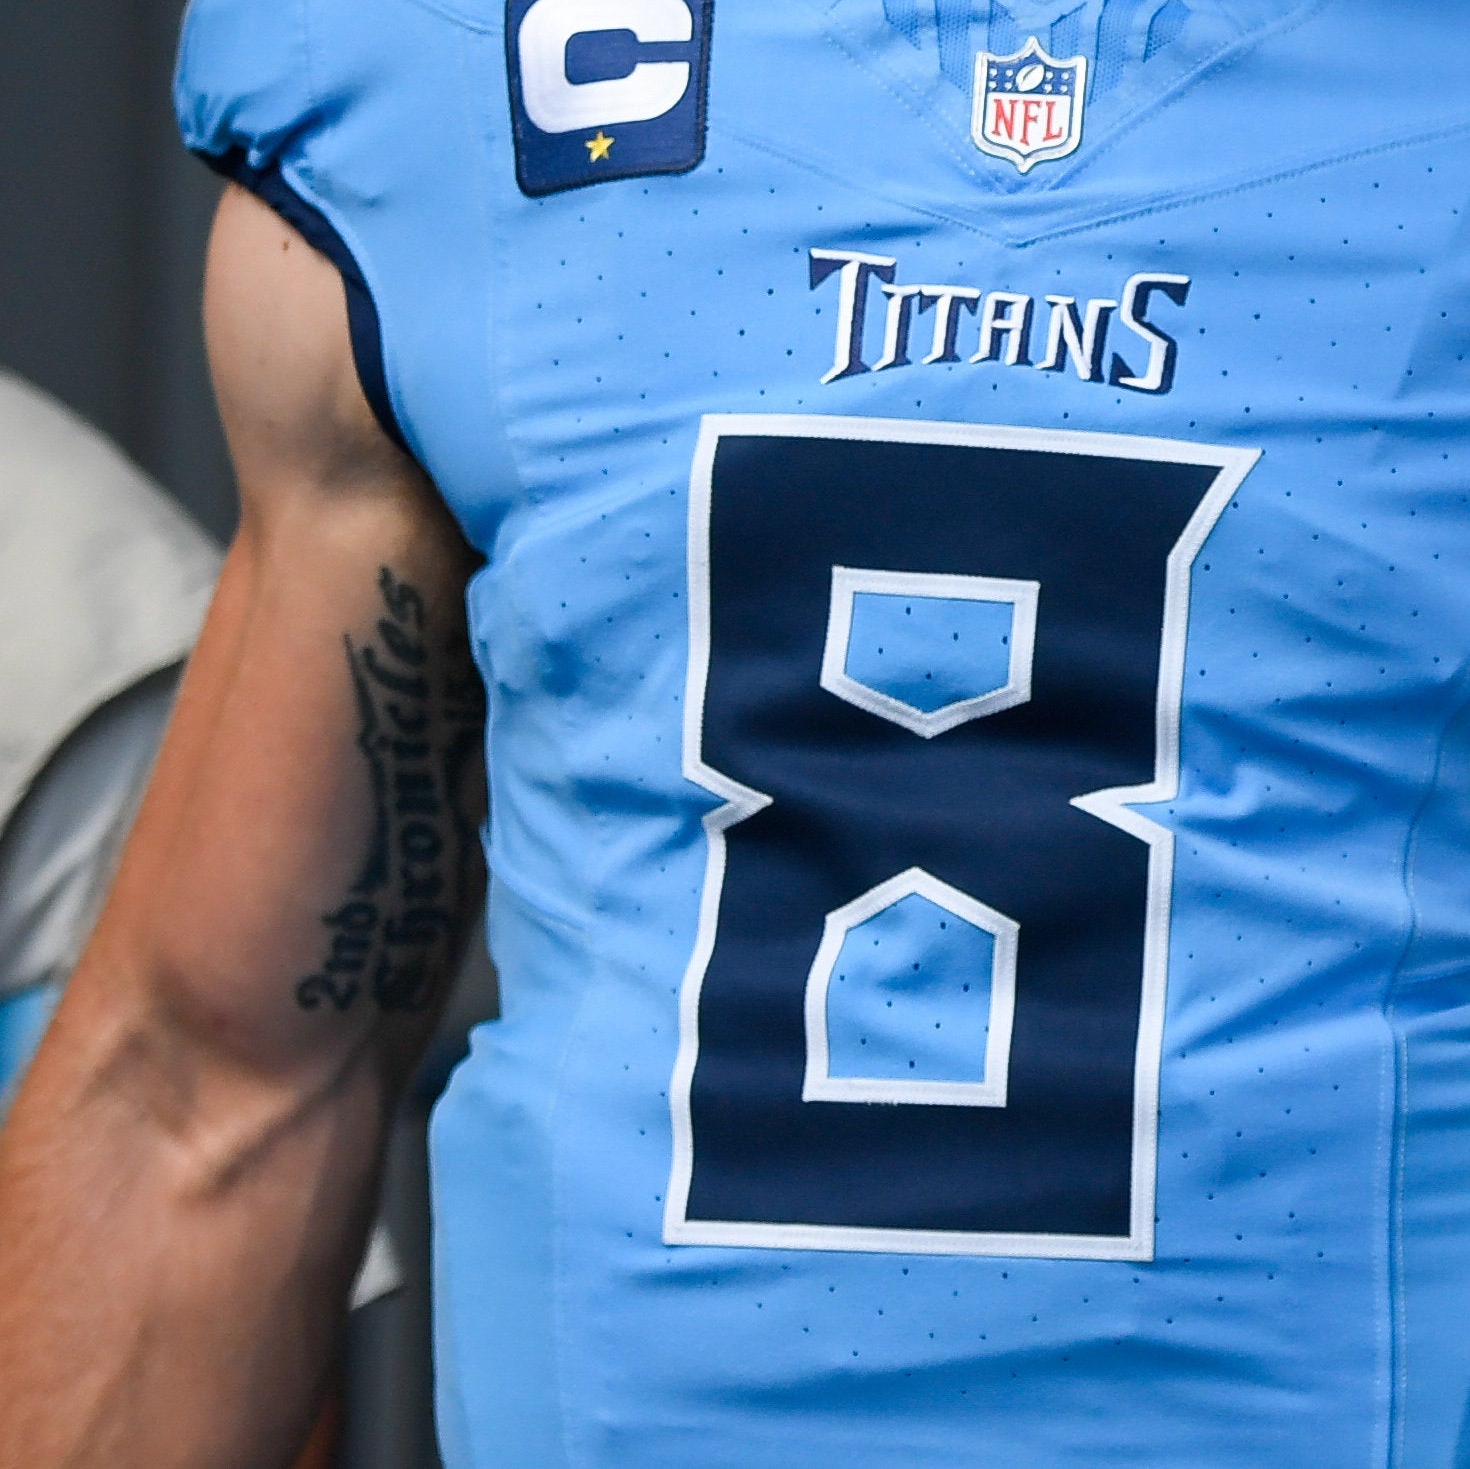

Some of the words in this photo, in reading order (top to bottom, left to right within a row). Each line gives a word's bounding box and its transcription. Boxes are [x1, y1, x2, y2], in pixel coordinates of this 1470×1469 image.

[991, 97, 1063, 145] NFL
[808, 247, 1192, 395] TITANS
[360, 567, 453, 1013] Chronicles
[662, 412, 1263, 1263] 8
